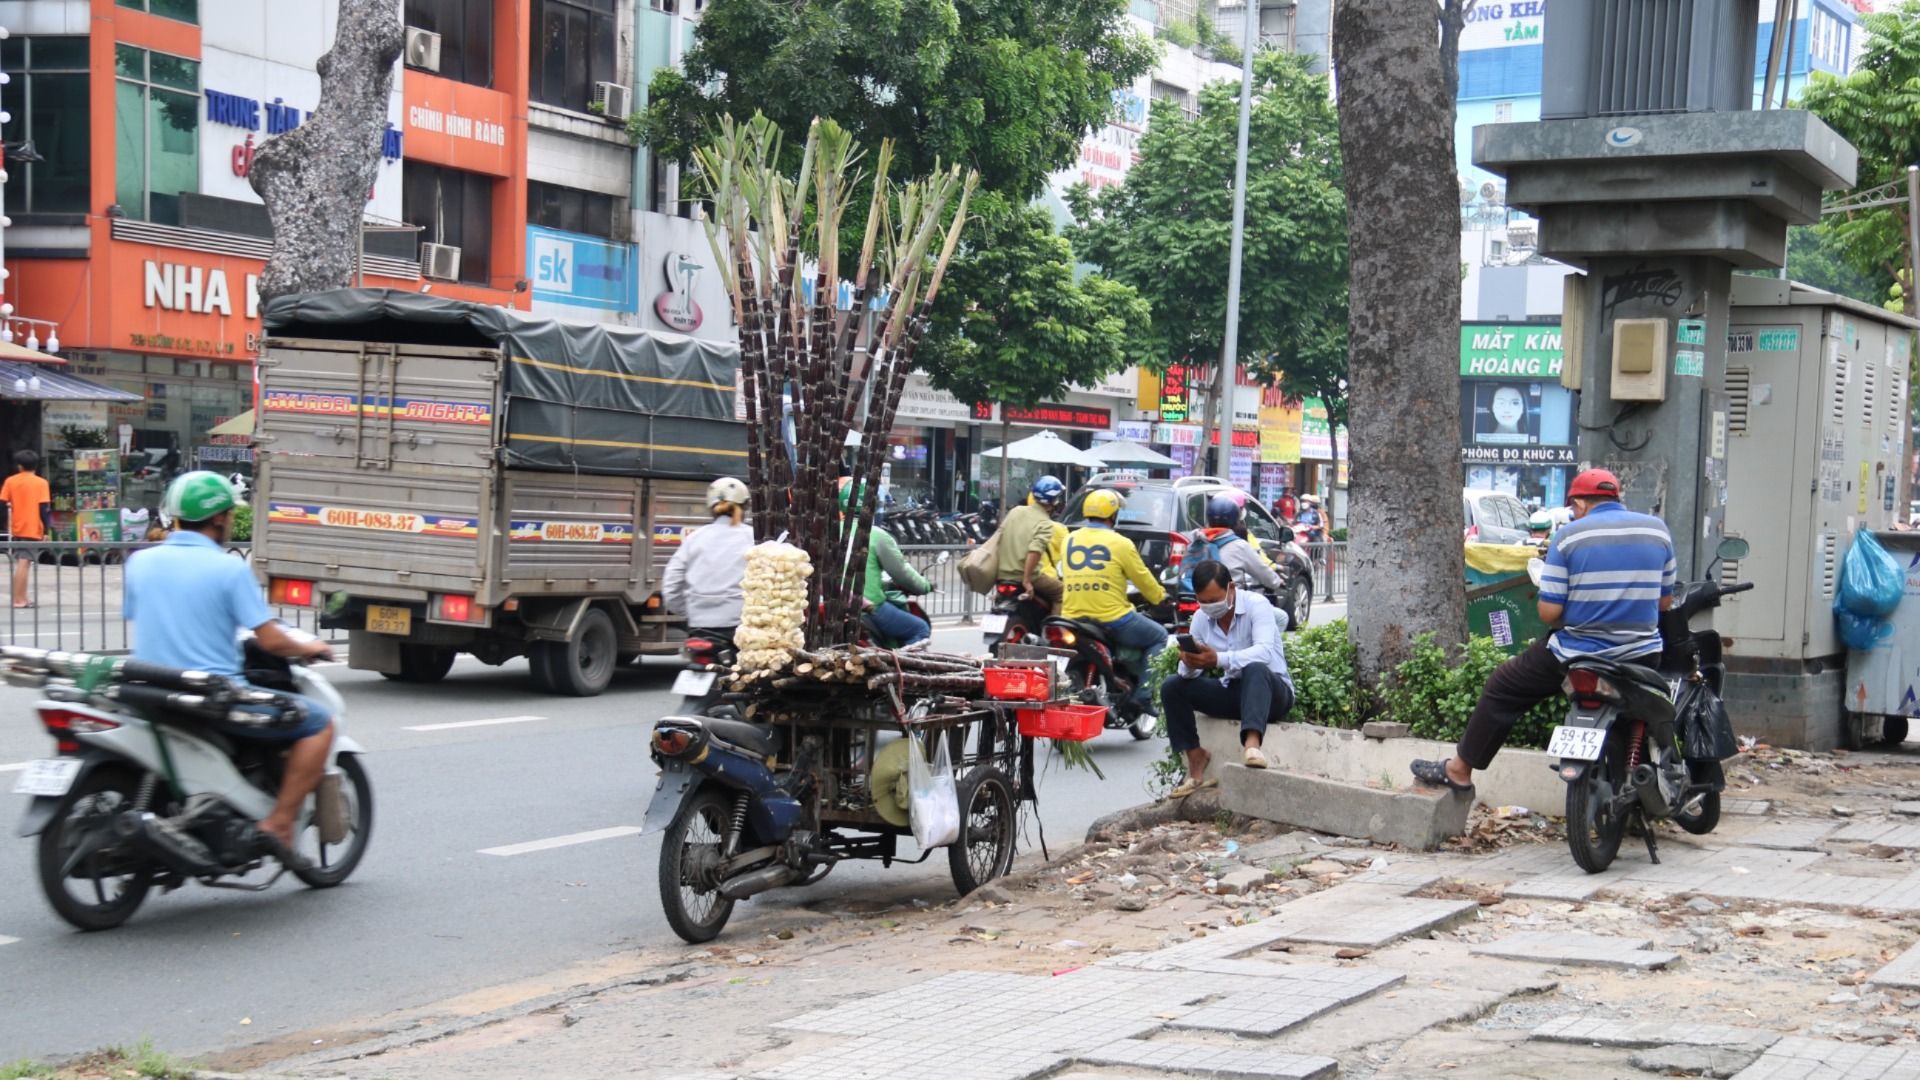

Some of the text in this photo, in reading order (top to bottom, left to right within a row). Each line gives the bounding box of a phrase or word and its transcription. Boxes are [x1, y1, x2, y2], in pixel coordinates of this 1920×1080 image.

[205, 88, 299, 135] TRUNG TÂM
[409, 101, 505, 146] CHỈNH HÌNH RĂNG
[539, 249, 567, 284] sk
[144, 260, 232, 316] NHA
[1472, 326, 1563, 350] MẮT KÍN
[1470, 354, 1540, 374] HOÀNG
[267, 392, 488, 421] HYUNDAI MIGHTY
[1462, 446, 1573, 462] PHÒNG ĐO KHÚC XẠ
[327, 509, 416, 531] 60H-083.37
[545, 524, 599, 540] 60H-083.37
[1067, 537, 1111, 571] be
[379, 607, 399, 619] 60H
